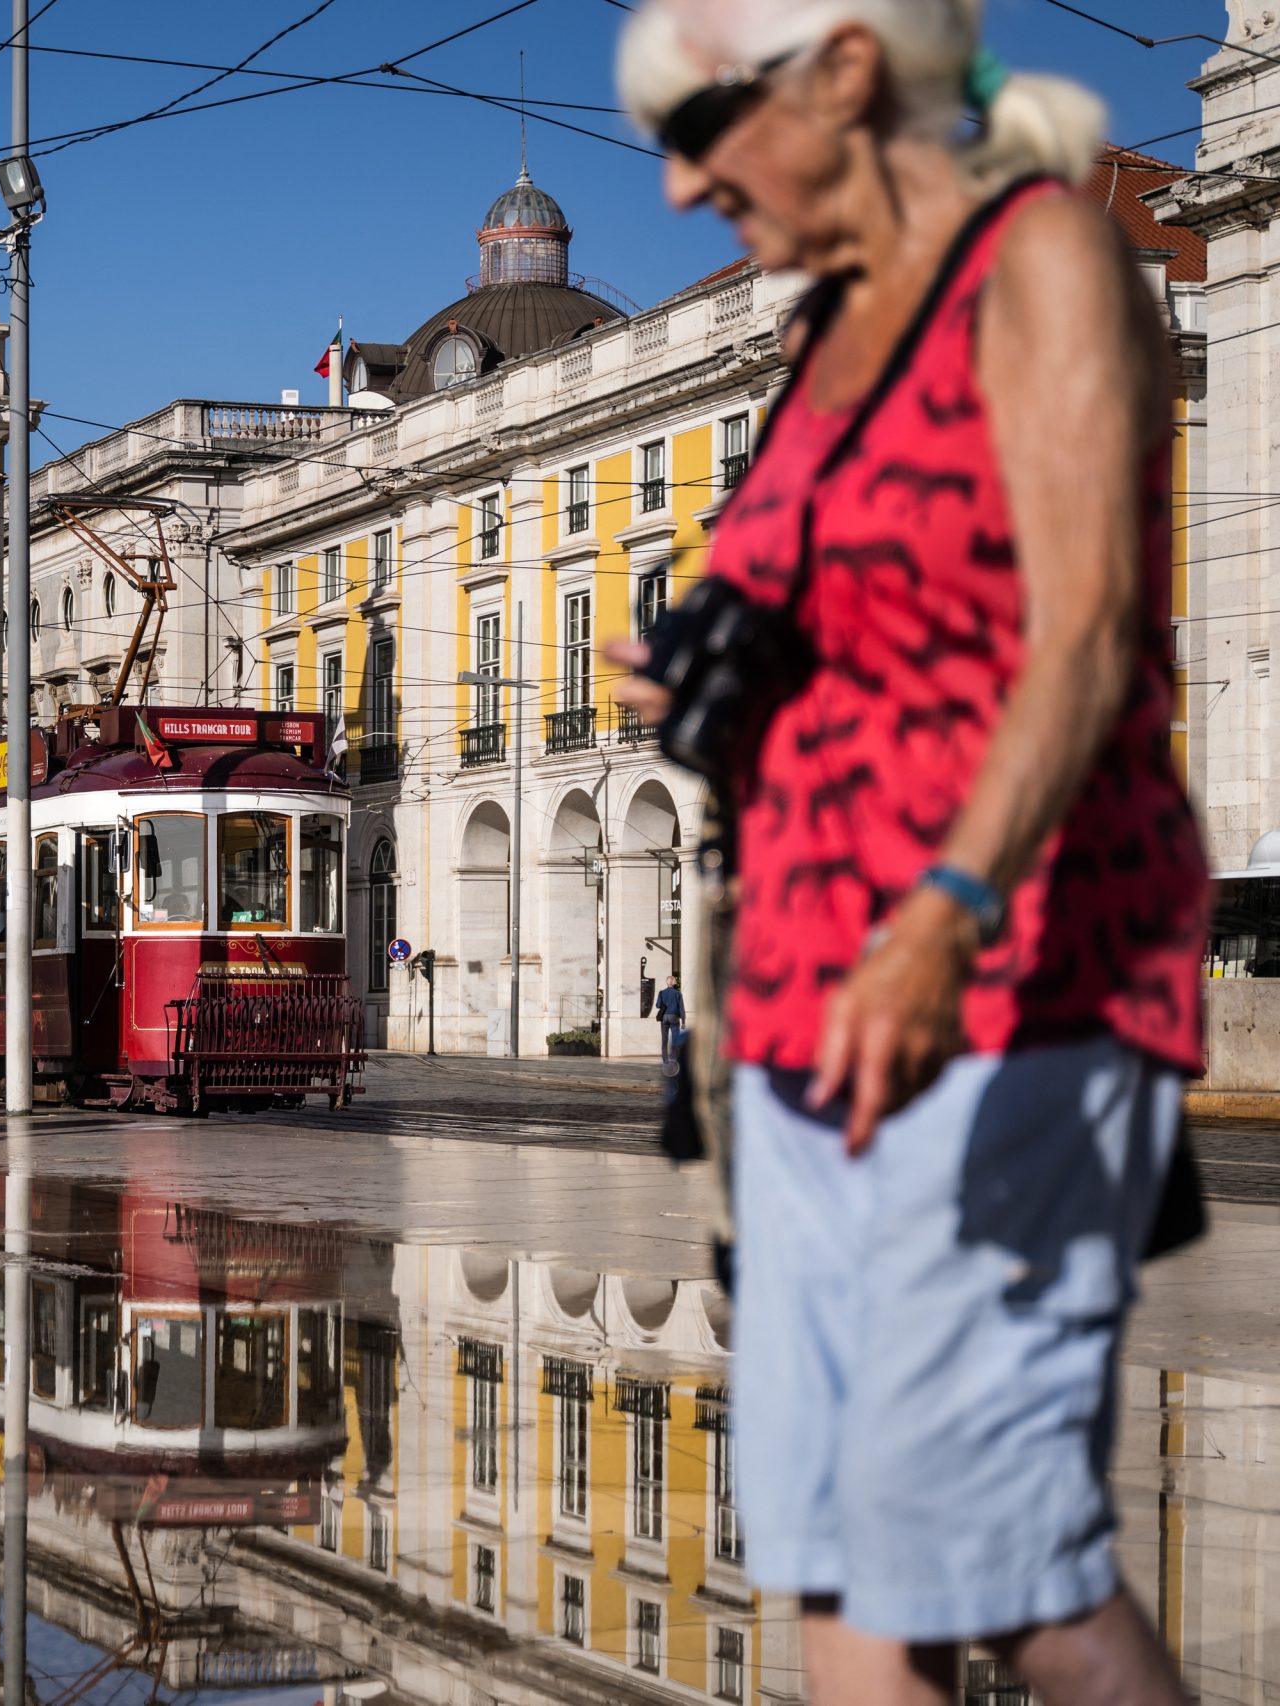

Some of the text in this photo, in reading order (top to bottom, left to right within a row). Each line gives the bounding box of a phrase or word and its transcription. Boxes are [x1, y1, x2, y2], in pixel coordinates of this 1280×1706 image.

[164, 723, 252, 735] HILLS TRAMCAR TOUR
[661, 900, 681, 911] PESTA
